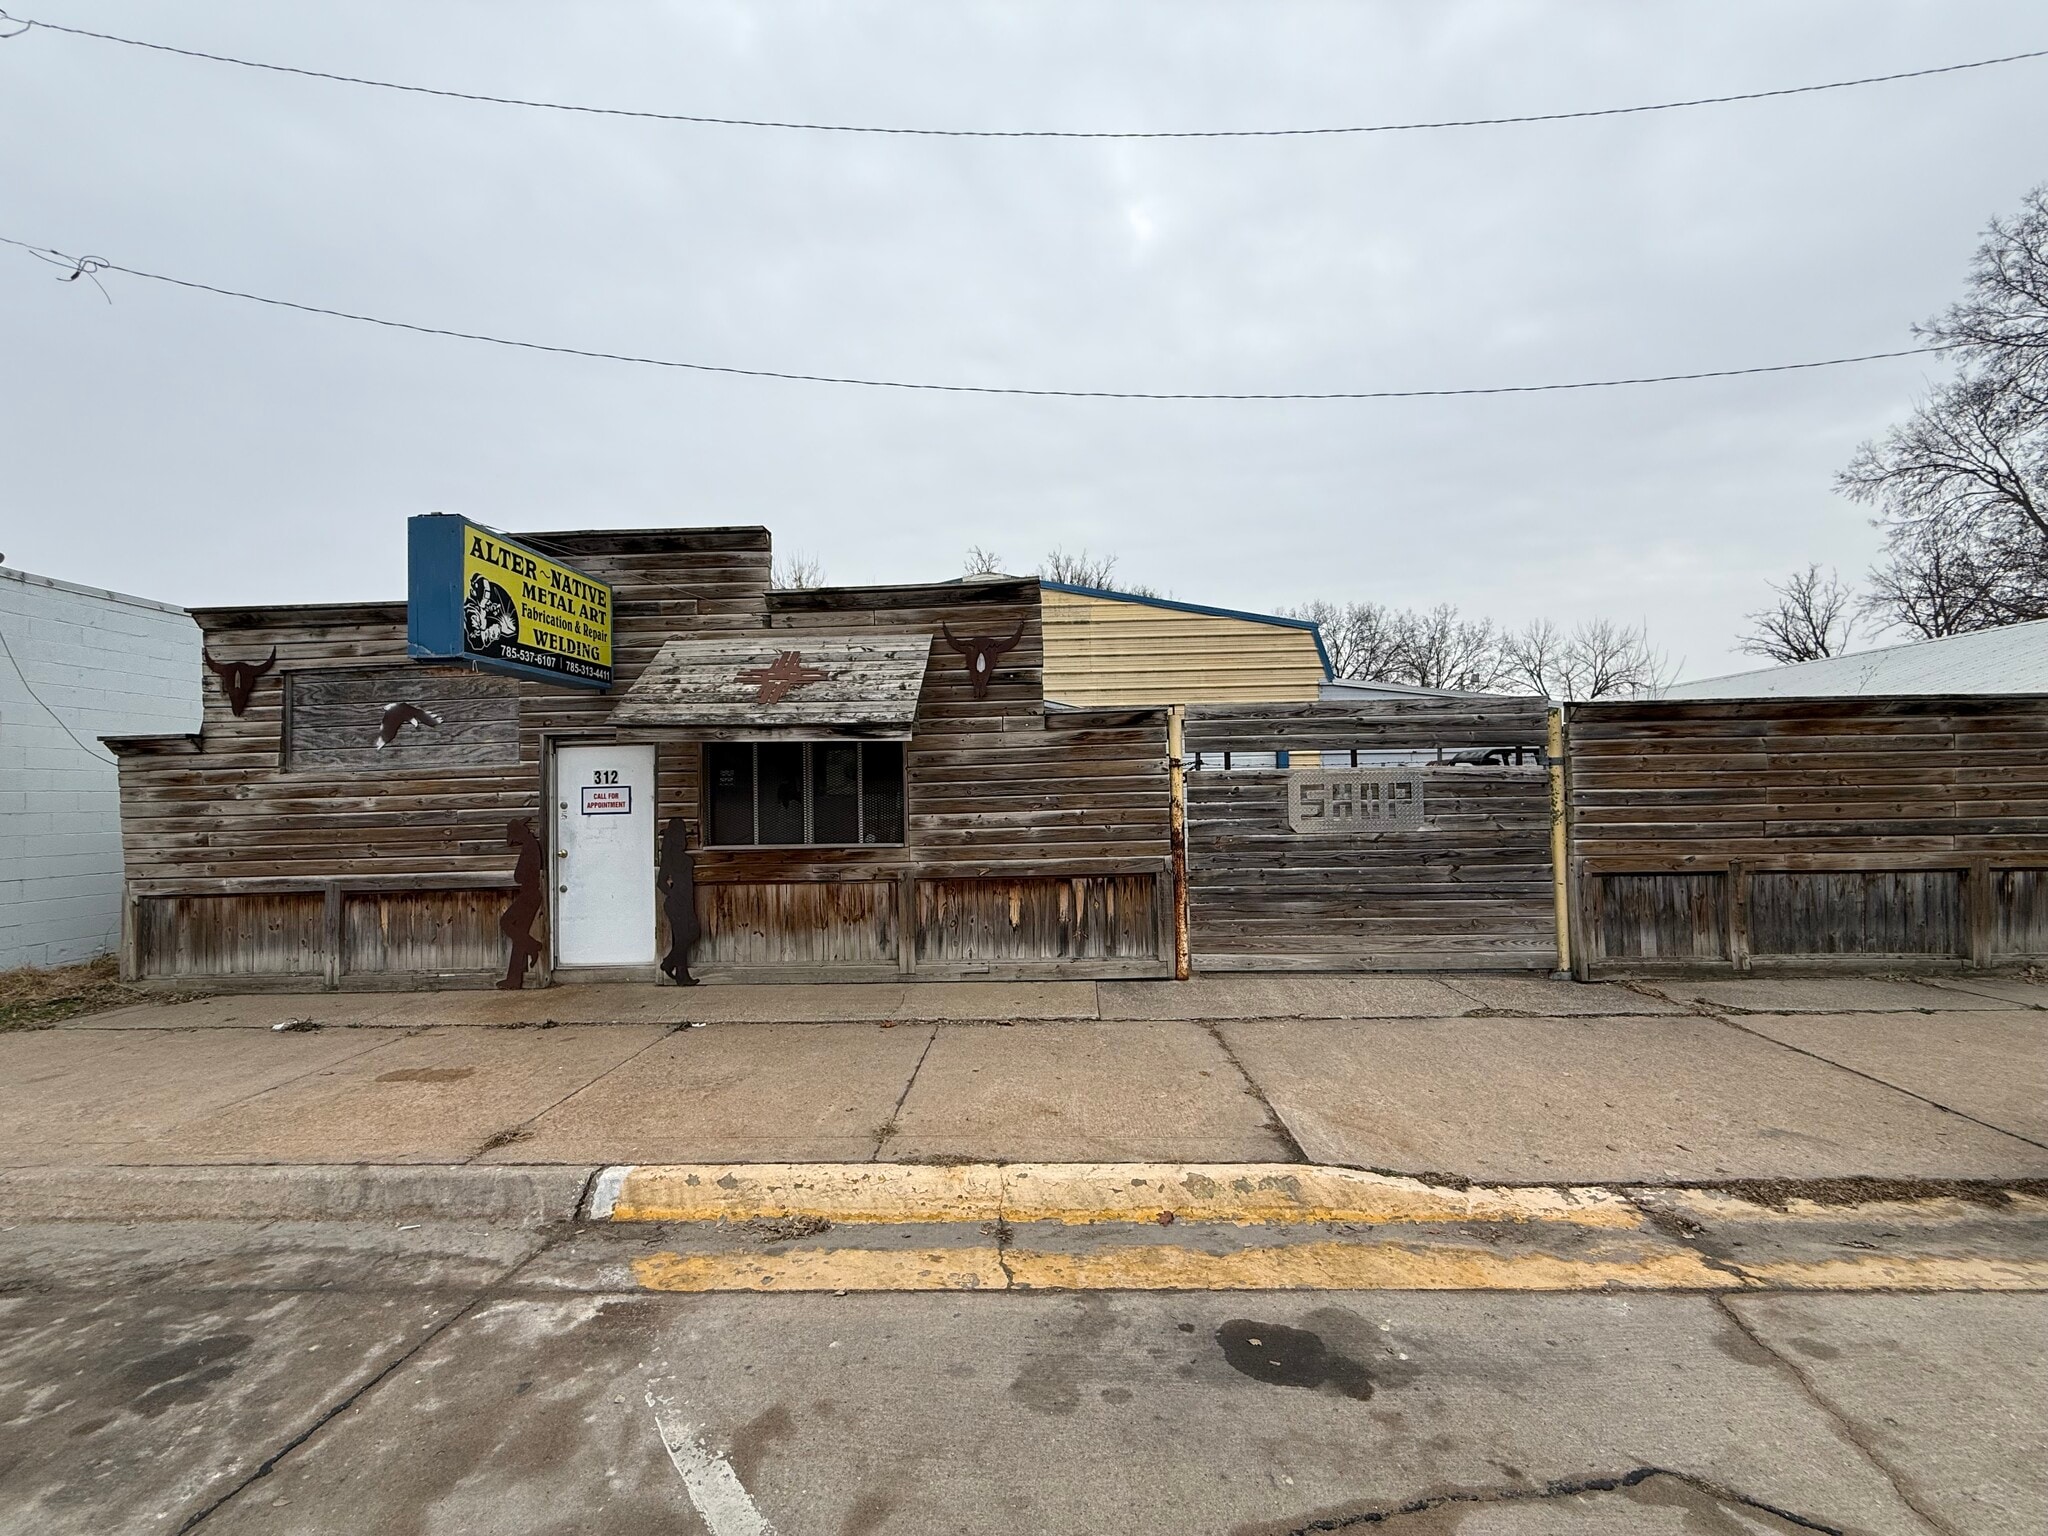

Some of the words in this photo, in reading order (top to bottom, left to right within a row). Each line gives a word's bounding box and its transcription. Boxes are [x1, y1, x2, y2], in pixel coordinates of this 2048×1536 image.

[522, 581, 576, 615] METAL
[579, 605, 606, 625] ART
[521, 603, 572, 632] Fabrication
[574, 621, 581, 635] &
[583, 623, 608, 643] Repair
[533, 628, 600, 661] WELDING
[500, 645, 556, 667] 785-537-6107
[566, 661, 610, 681] 785-313-4411
[594, 770, 618, 784] 312
[1300, 783, 1412, 820] SHOP
